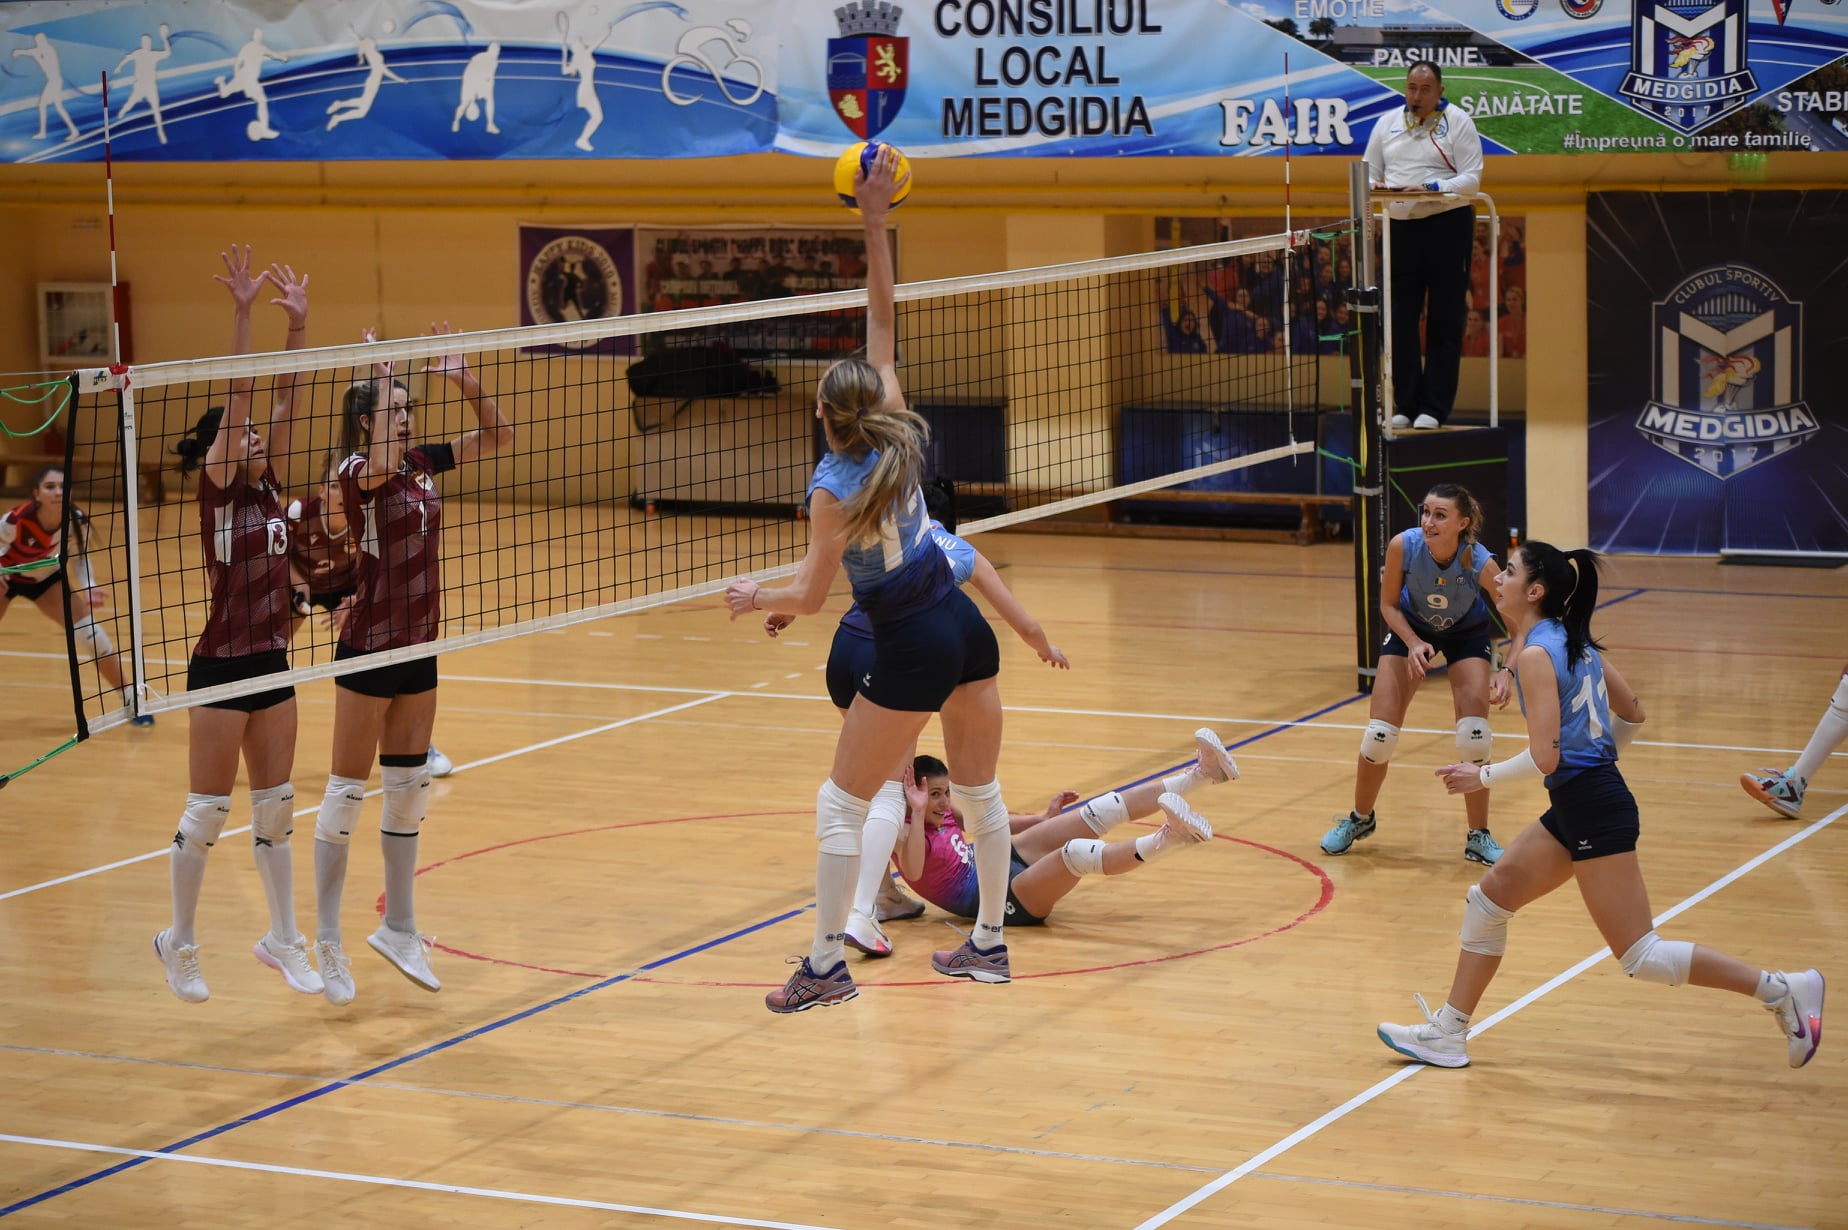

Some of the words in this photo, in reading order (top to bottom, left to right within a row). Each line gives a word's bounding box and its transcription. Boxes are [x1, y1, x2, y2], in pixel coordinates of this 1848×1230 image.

[934, 0, 1162, 37] CONSILIUL
[975, 46, 1120, 87] LOCAL
[1374, 47, 1478, 68] PASIUNE
[1460, 90, 1583, 116] SĂNĂTATE
[1633, 78, 1742, 99] MEDGIDIA
[942, 96, 1155, 137] MEDGIDIA
[1219, 97, 1354, 146] FAIR
[1664, 105, 1711, 117] 2017
[1673, 136, 1685, 148] o
[1691, 135, 1739, 147] mare
[1745, 131, 1811, 146] familie
[1675, 273, 1722, 304] CLUBUL
[1726, 270, 1780, 302] SPORTIV
[1644, 406, 1814, 440] MEDGIDIA
[1694, 448, 1758, 463] 2017
[267, 517, 288, 555] 13
[1427, 594, 1449, 610] 9
